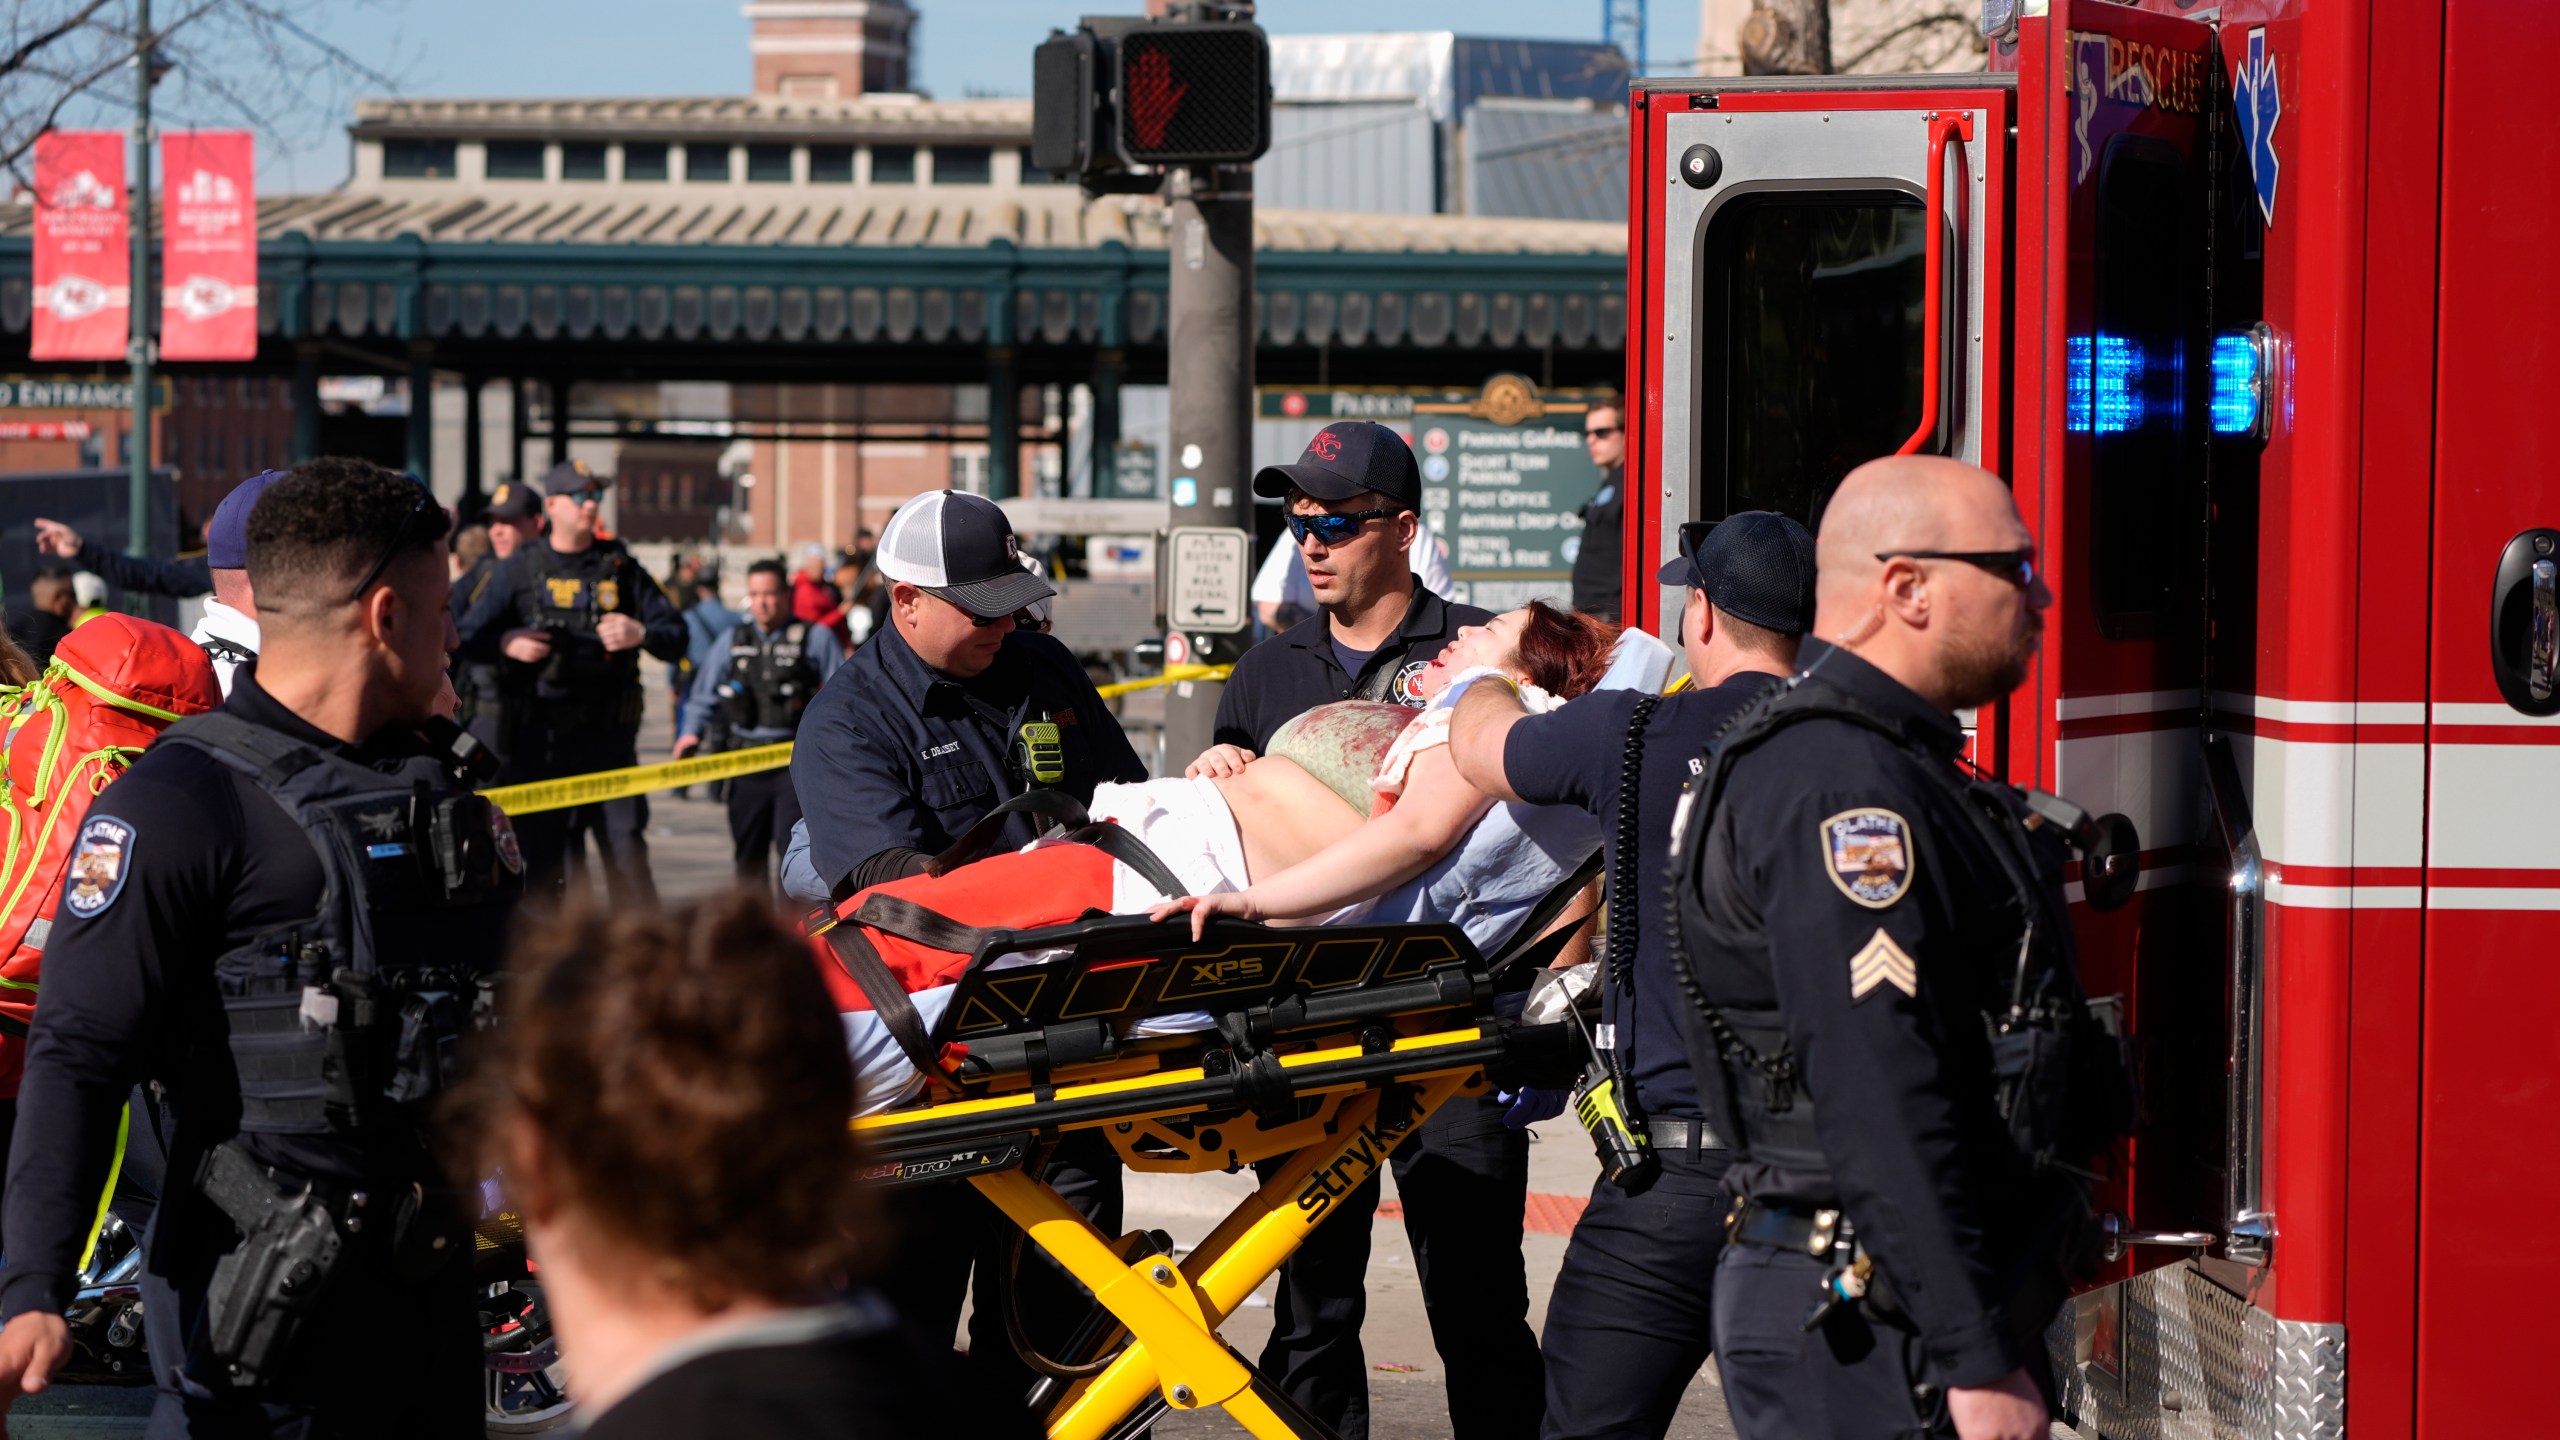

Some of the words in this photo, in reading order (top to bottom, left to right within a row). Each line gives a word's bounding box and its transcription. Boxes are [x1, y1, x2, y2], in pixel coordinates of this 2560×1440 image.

[2107, 38, 2202, 113] RESCUE
[18, 380, 134, 408] ENTRANCE
[1331, 391, 1414, 417] PARKIN
[1458, 430, 1521, 448] PARKING
[1521, 429, 1582, 448] GARAGE
[1458, 452, 1507, 470] SHORT
[1510, 452, 1549, 470] TERM
[1458, 470, 1521, 486] PARKING
[1457, 490, 1497, 508] POST
[1498, 490, 1552, 508] OFFICE
[1517, 512, 1559, 530] DROP
[1192, 538, 1226, 548] PUSH
[1458, 535, 1510, 551] METRO
[1185, 552, 1233, 562] BUTTON
[1458, 551, 1499, 567] PARK
[1515, 550, 1552, 567] RIDE
[1196, 564, 1221, 574] FOR
[1192, 577, 1223, 587] WALK
[1185, 589, 1230, 600] SIGNAL
[1832, 814, 1899, 837] OLATHE
[1191, 957, 1263, 981] XPS
[1297, 1084, 1426, 1224] strykr
[904, 1160, 951, 1178] pro
[951, 1151, 977, 1162] XT
